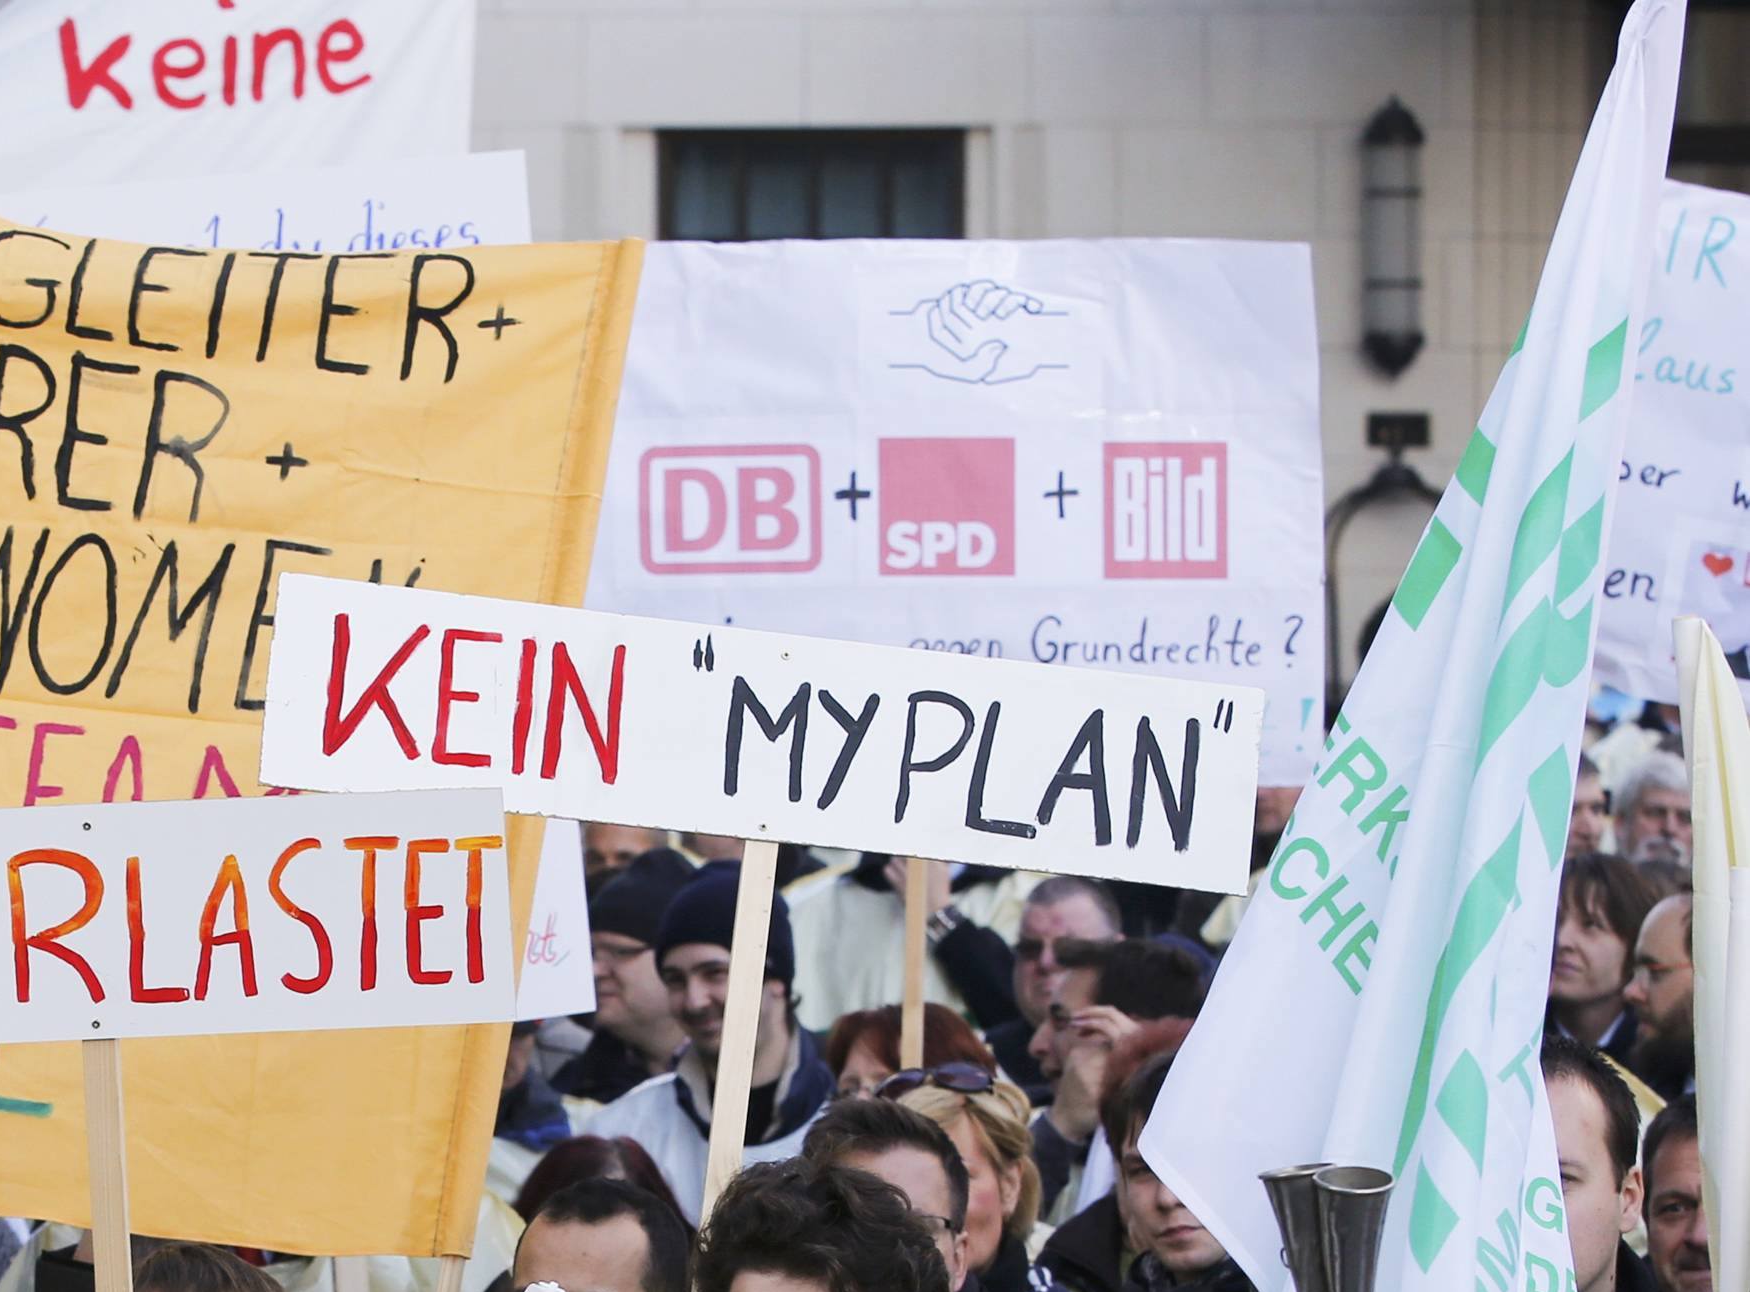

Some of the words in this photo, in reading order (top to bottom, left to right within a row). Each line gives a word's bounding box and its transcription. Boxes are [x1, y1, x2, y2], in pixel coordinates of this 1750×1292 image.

[59, 0, 373, 110] keine
[663, 465, 800, 553] DB
[885, 521, 997, 570] SPD
[1114, 456, 1218, 563] Bild
[1030, 614, 1263, 667] Grundrechte
[322, 611, 628, 785] KEIN
